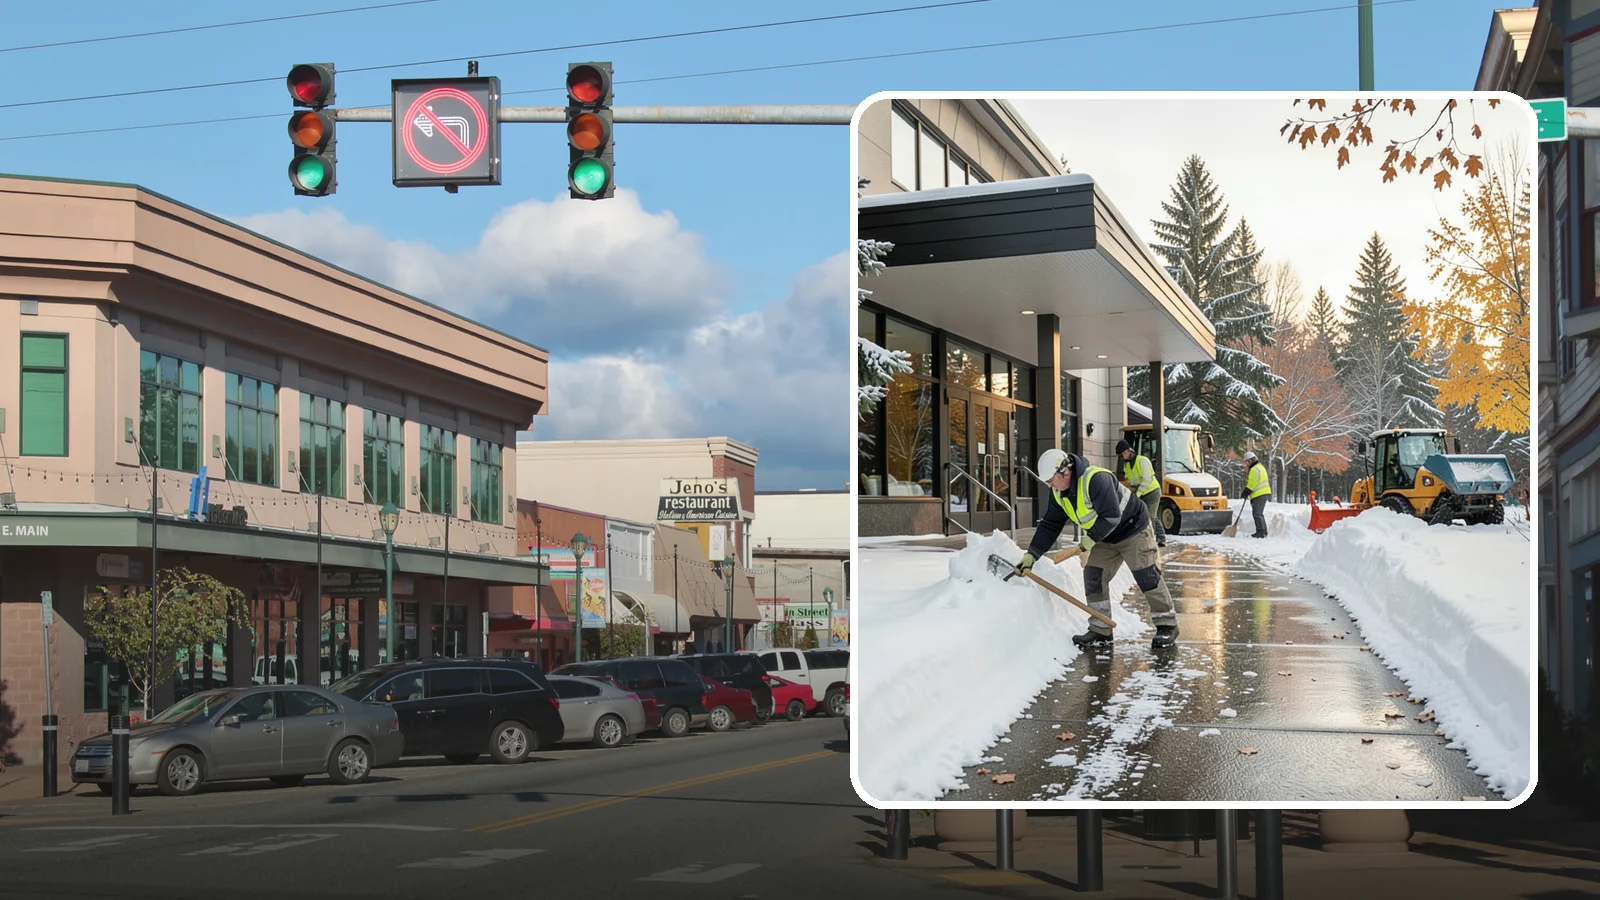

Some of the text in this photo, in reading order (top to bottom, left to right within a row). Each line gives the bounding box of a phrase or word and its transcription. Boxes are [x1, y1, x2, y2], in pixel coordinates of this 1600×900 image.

[669, 480, 728, 494] Jeno's
[665, 497, 731, 509] restaurant
[659, 510, 682, 519] Italian
[686, 510, 714, 519] American
[715, 509, 737, 519] Cuisine
[2, 525, 49, 536] E. MAIN
[797, 608, 828, 616] Street
